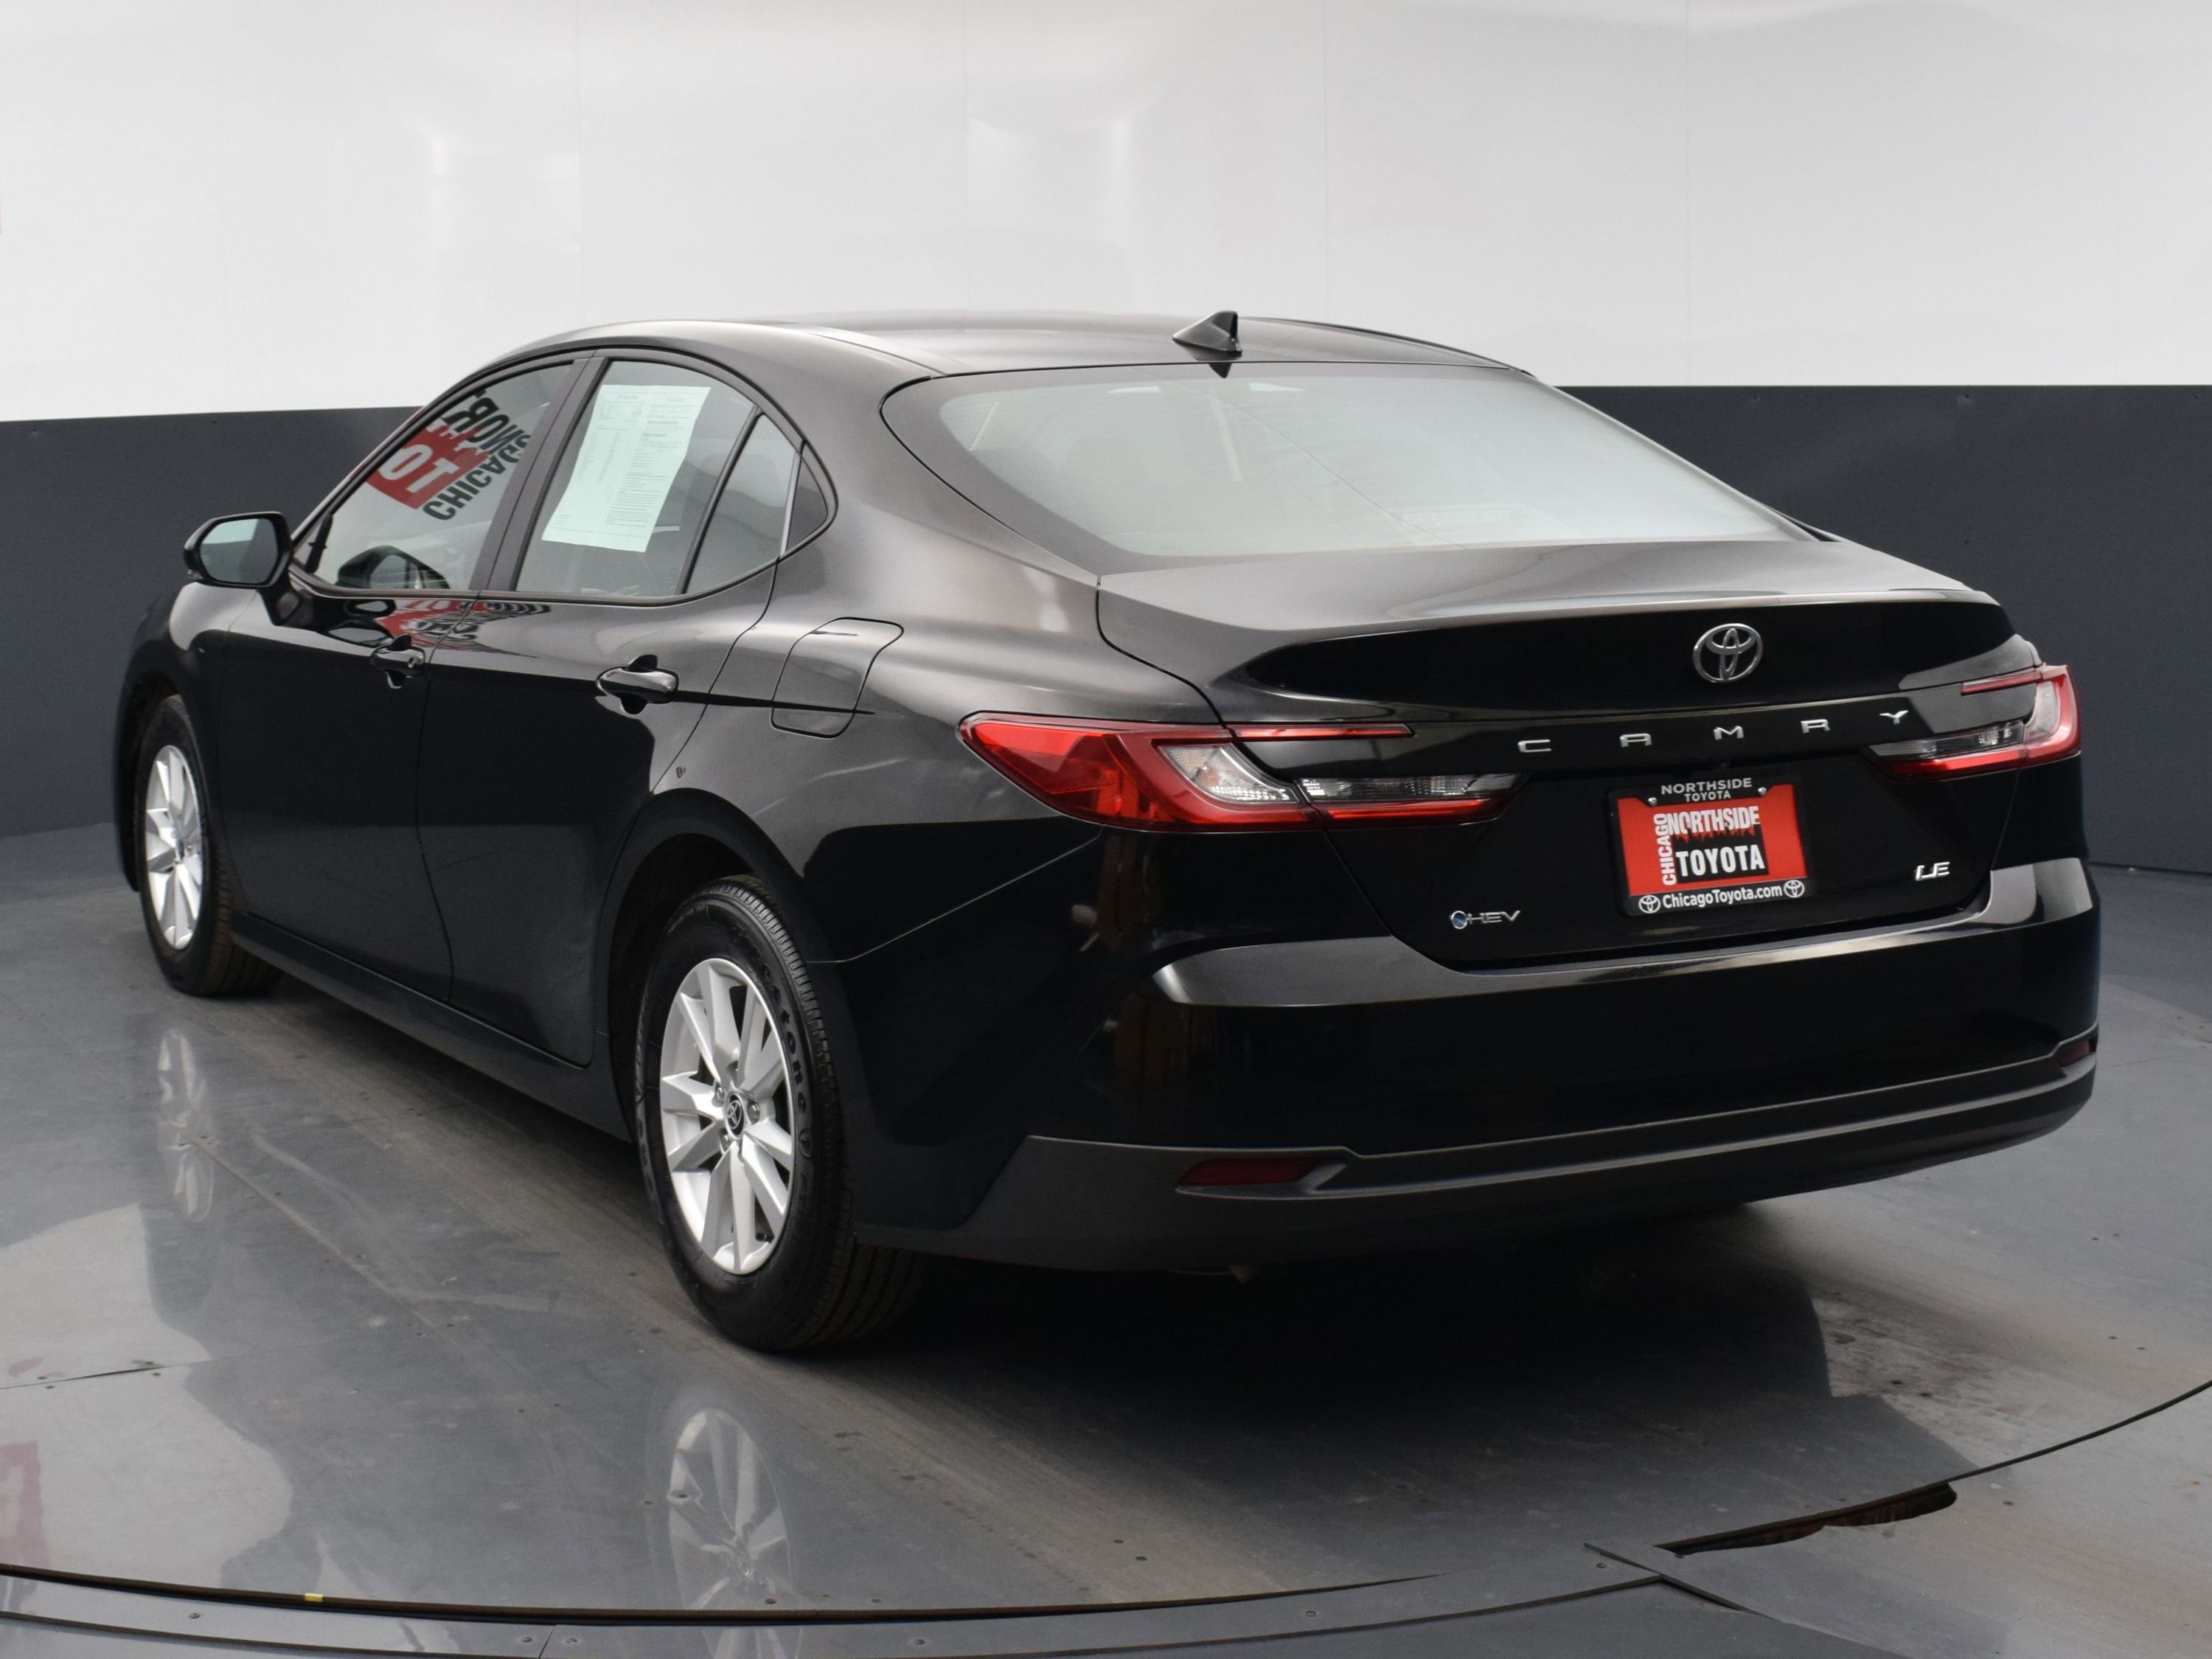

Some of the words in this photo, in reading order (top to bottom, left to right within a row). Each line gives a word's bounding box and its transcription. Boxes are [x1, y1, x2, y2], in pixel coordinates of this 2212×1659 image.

[1517, 709, 1908, 753] CAMRY
[1661, 778, 1752, 794] NORTHSIDE
[1685, 791, 1731, 802] TOYOTA
[1667, 806, 1761, 835] NORTHSIDE
[1655, 814, 1677, 885] CHICAGO
[1675, 844, 1765, 877] TOYOTA
[1915, 861, 1950, 881] LE
[1663, 886, 1782, 908] ChicagoToyota.com
